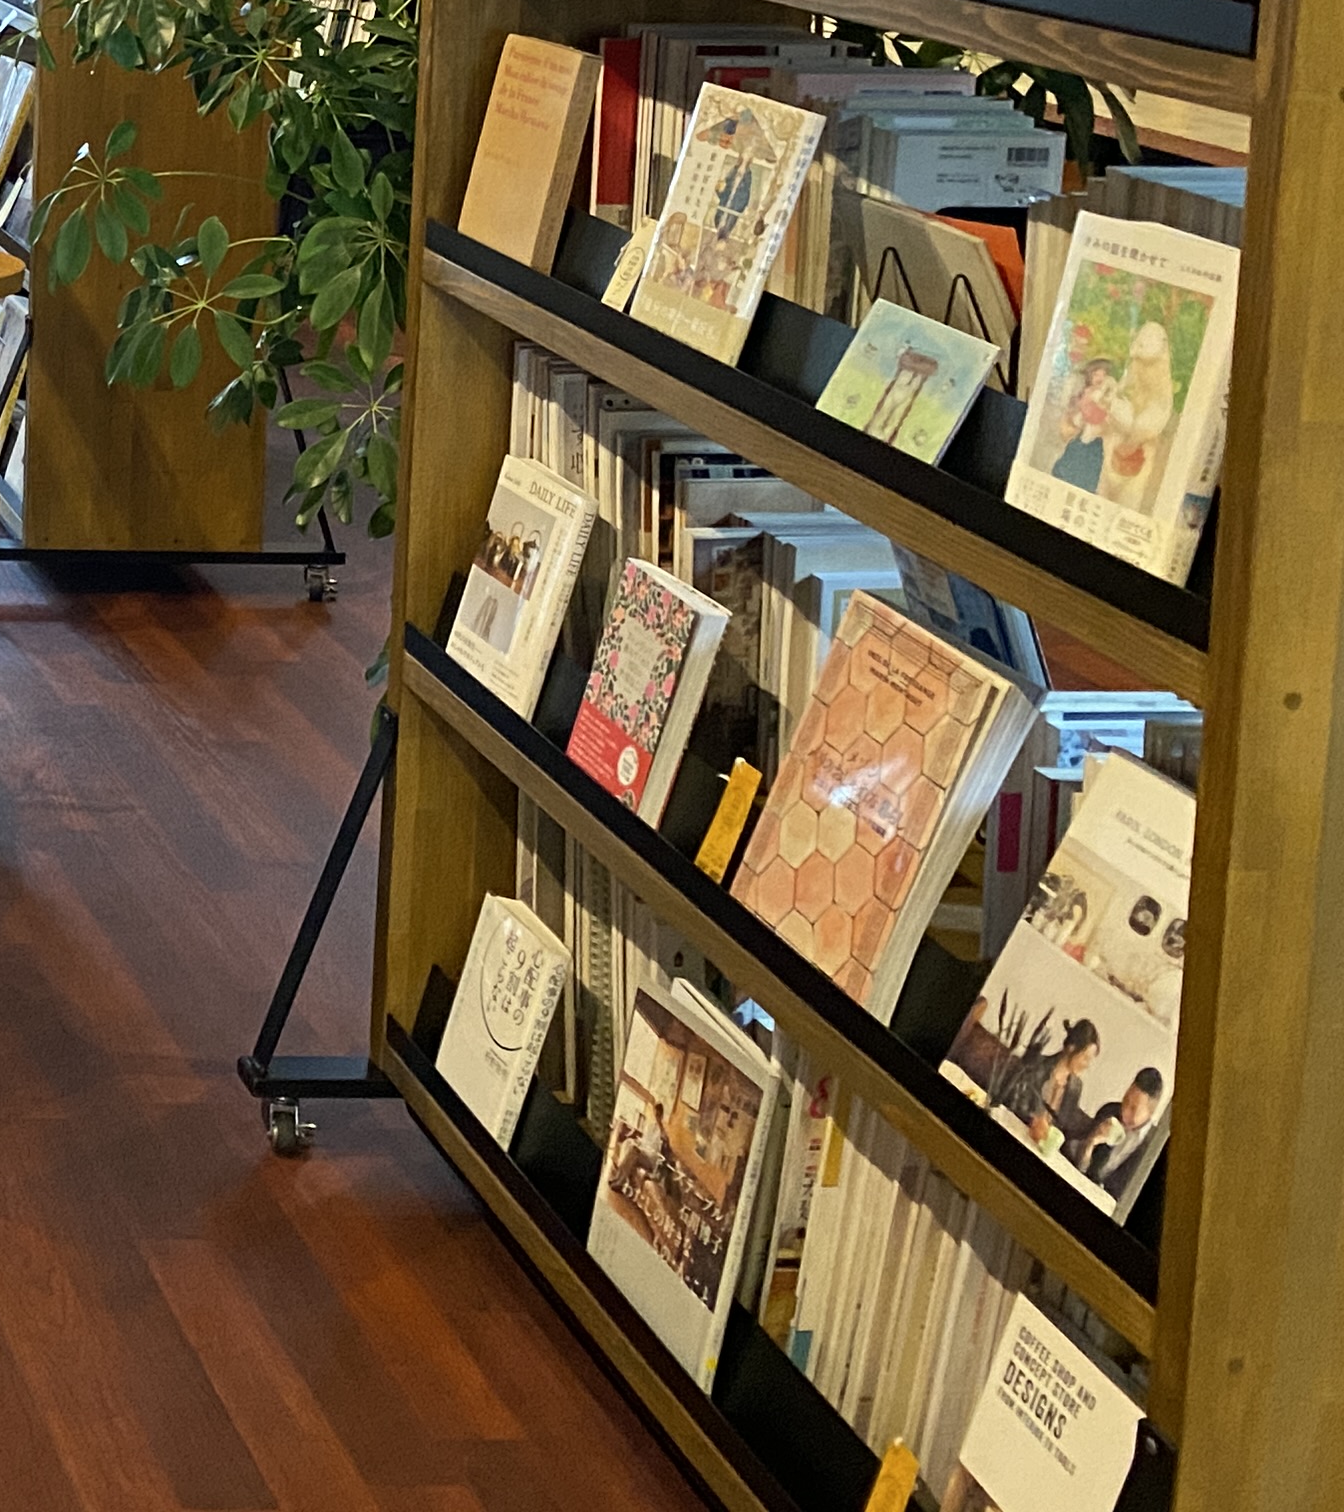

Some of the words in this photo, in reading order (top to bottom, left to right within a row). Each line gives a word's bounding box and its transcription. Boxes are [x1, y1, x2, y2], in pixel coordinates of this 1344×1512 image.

[529, 481, 556, 507] DAILY
[556, 498, 577, 519] LIFE
[575, 512, 595, 551] DAILY
[567, 552, 582, 578] LIFE
[1013, 1342, 1053, 1388] CONCEPT
[1052, 1382, 1082, 1420] STORE
[1019, 1326, 1052, 1366] COFFEE
[1052, 1359, 1077, 1389] SHOP
[1077, 1385, 1097, 1411] AND
[1003, 1360, 1067, 1440] DESIGNS
